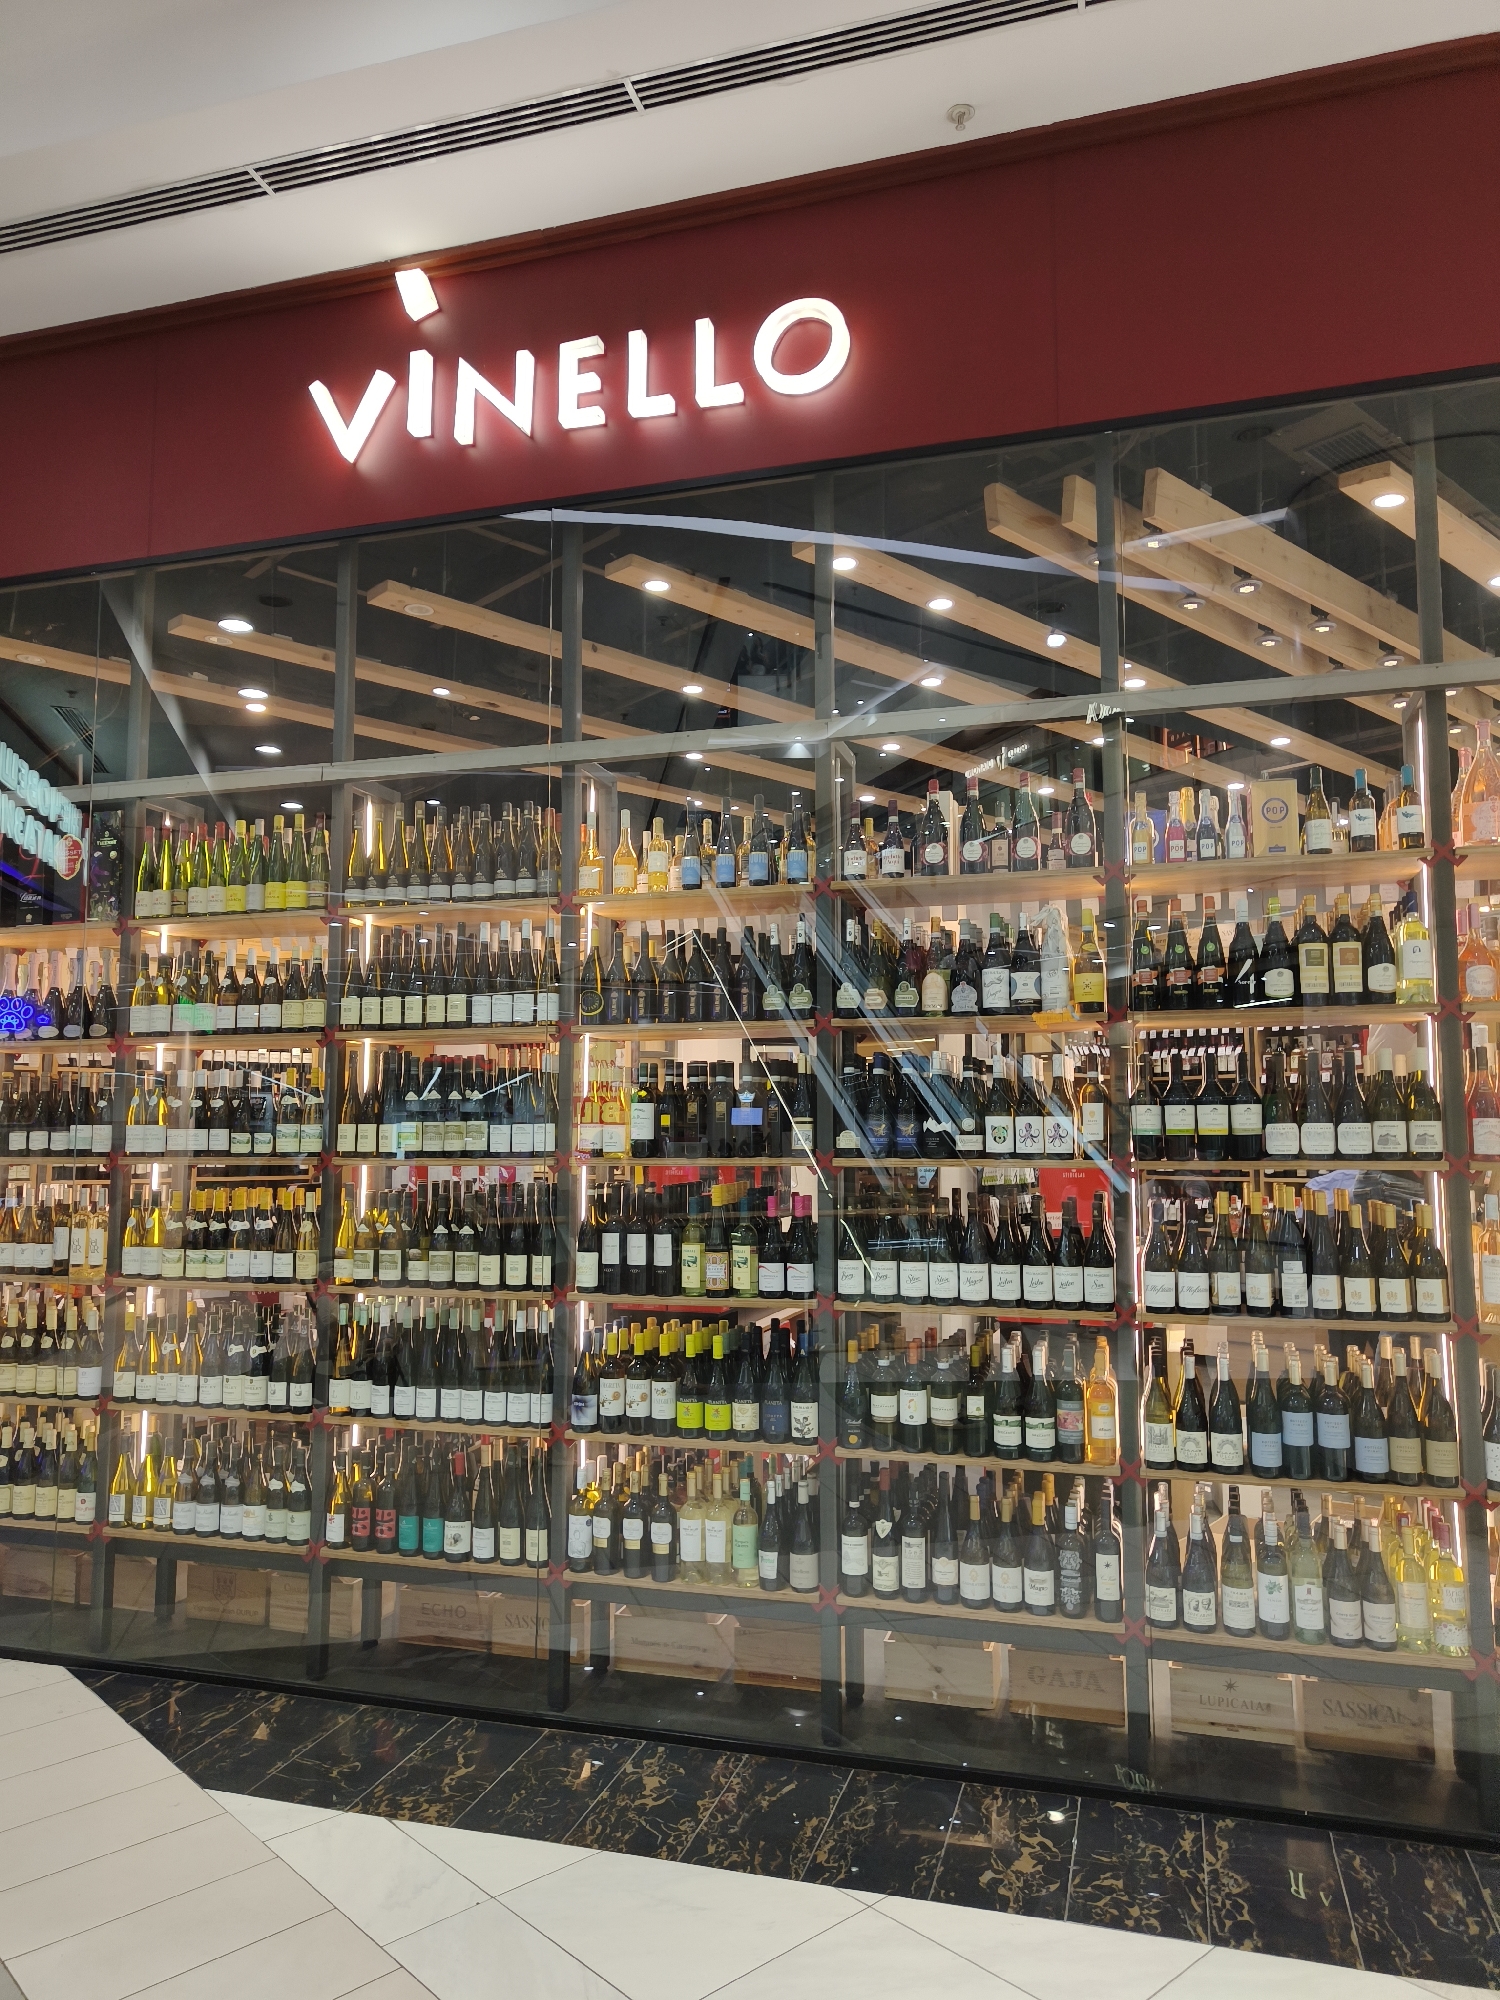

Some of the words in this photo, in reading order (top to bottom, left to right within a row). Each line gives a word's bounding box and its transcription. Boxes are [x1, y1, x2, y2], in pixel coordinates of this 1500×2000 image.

[308, 267, 851, 464] VINELLO
[1266, 806, 1286, 814] POP
[1232, 840, 1244, 848] POP
[420, 1602, 467, 1619] ECHO
[1026, 1664, 1106, 1694] GAJA
[1199, 1694, 1265, 1712] LUPICAIA
